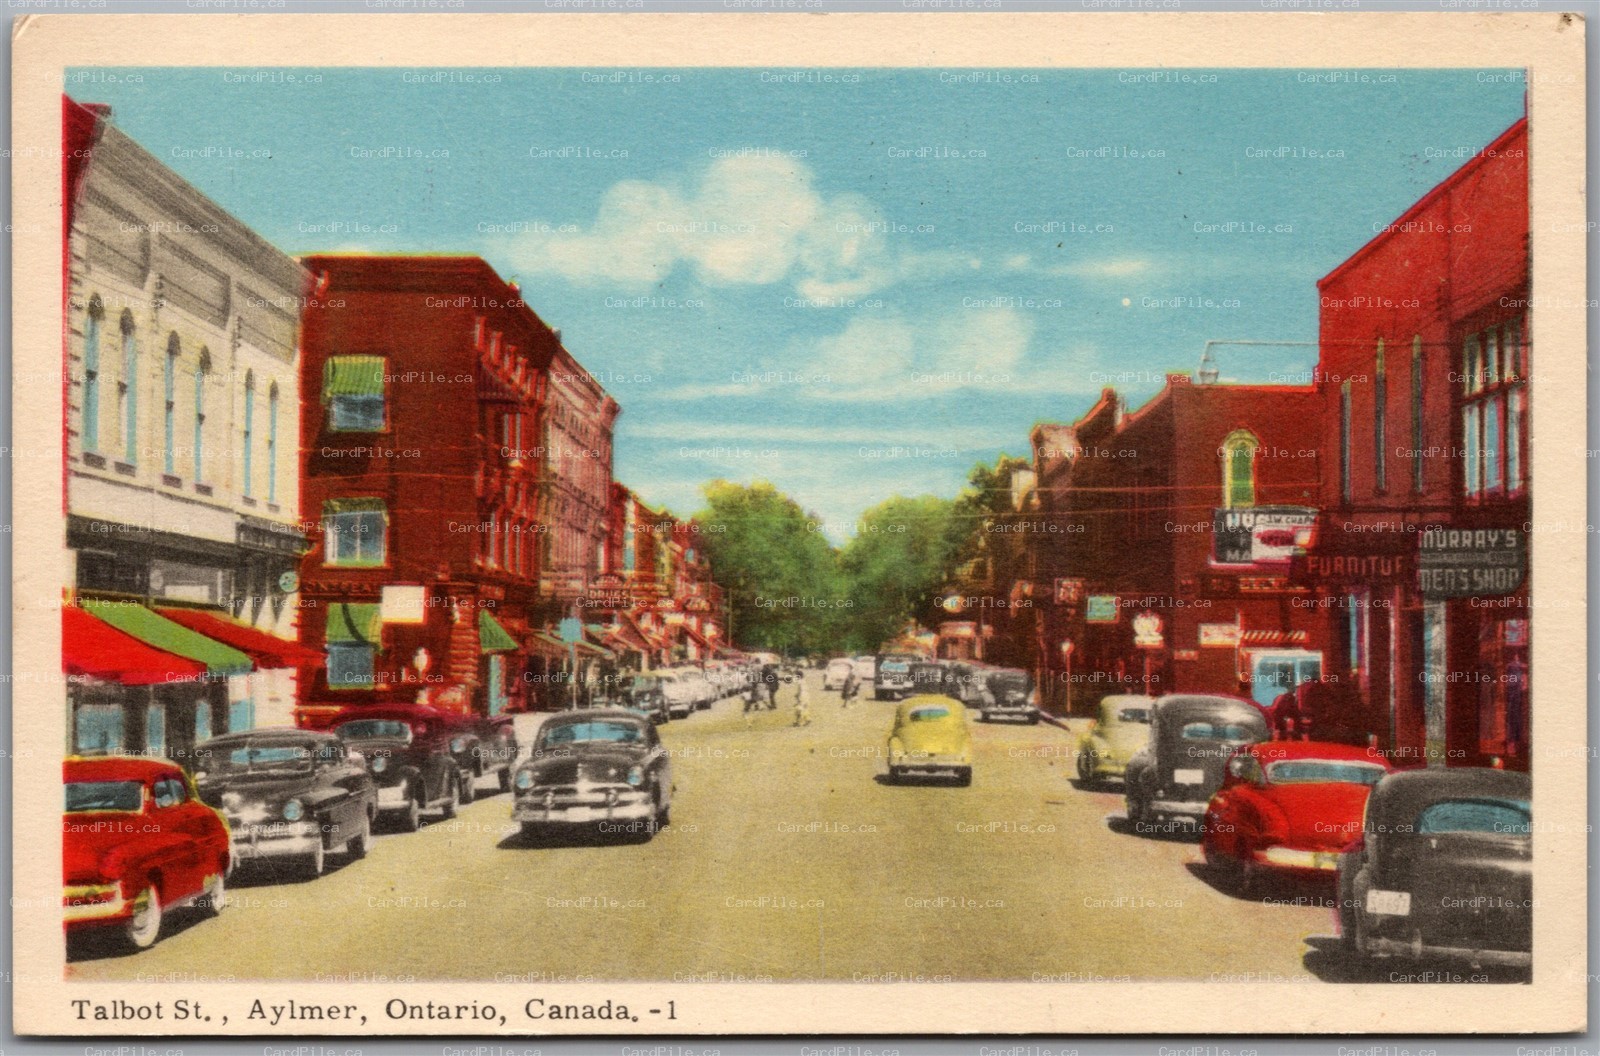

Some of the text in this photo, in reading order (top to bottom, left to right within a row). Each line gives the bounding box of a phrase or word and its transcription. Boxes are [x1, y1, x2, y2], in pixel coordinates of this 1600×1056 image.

[1418, 529, 1518, 549] MURRAY'S
[1417, 567, 1520, 592] MEN'S SHOP
